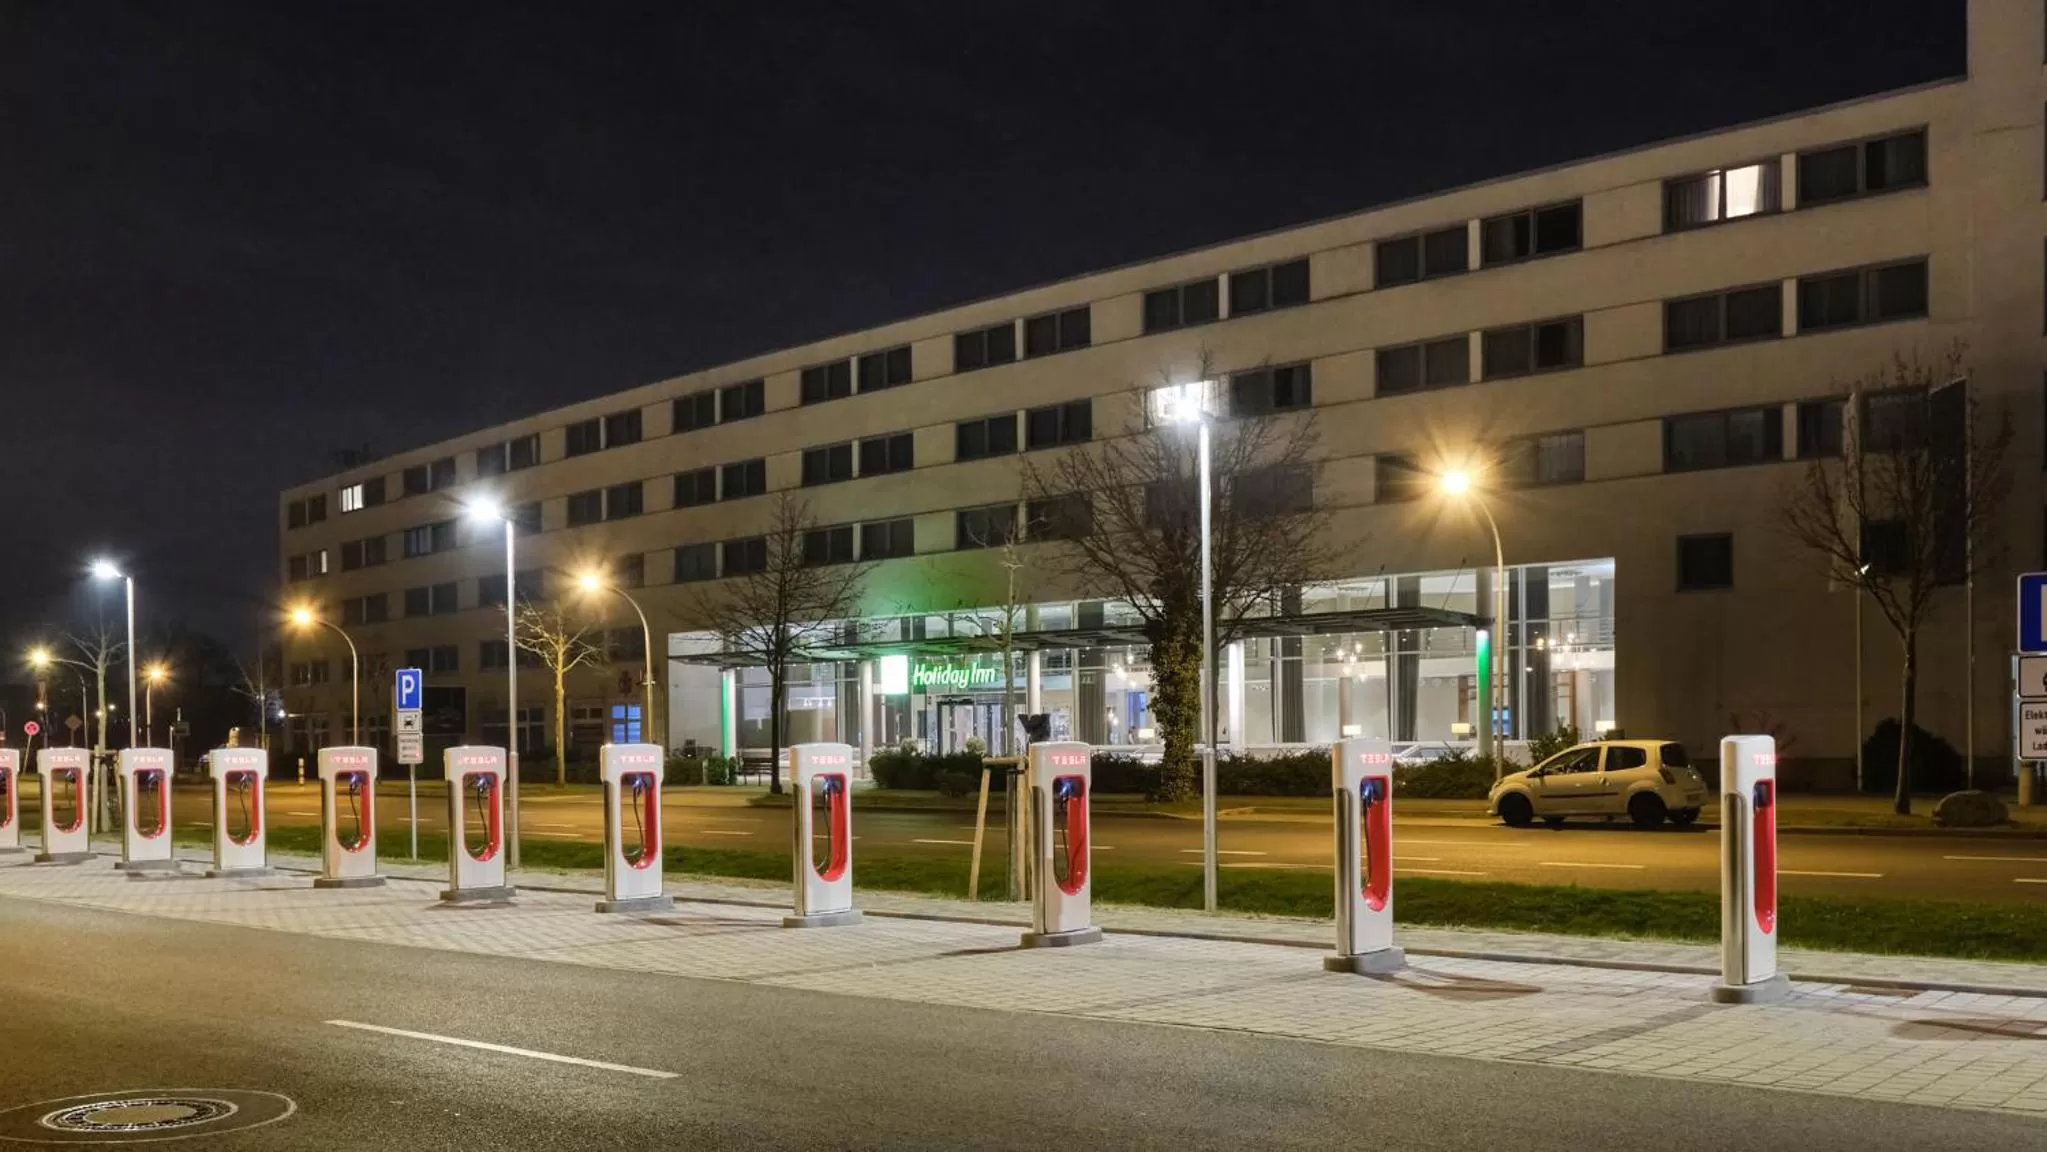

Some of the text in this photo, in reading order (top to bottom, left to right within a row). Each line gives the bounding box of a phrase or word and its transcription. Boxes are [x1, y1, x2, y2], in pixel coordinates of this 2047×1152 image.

[912, 661, 996, 689] Holiday Inn
[401, 674, 415, 705] P
[462, 755, 498, 764] TESLA
[621, 755, 656, 764] TESLA
[811, 755, 845, 765] TESLA
[1051, 755, 1086, 765] TESLA
